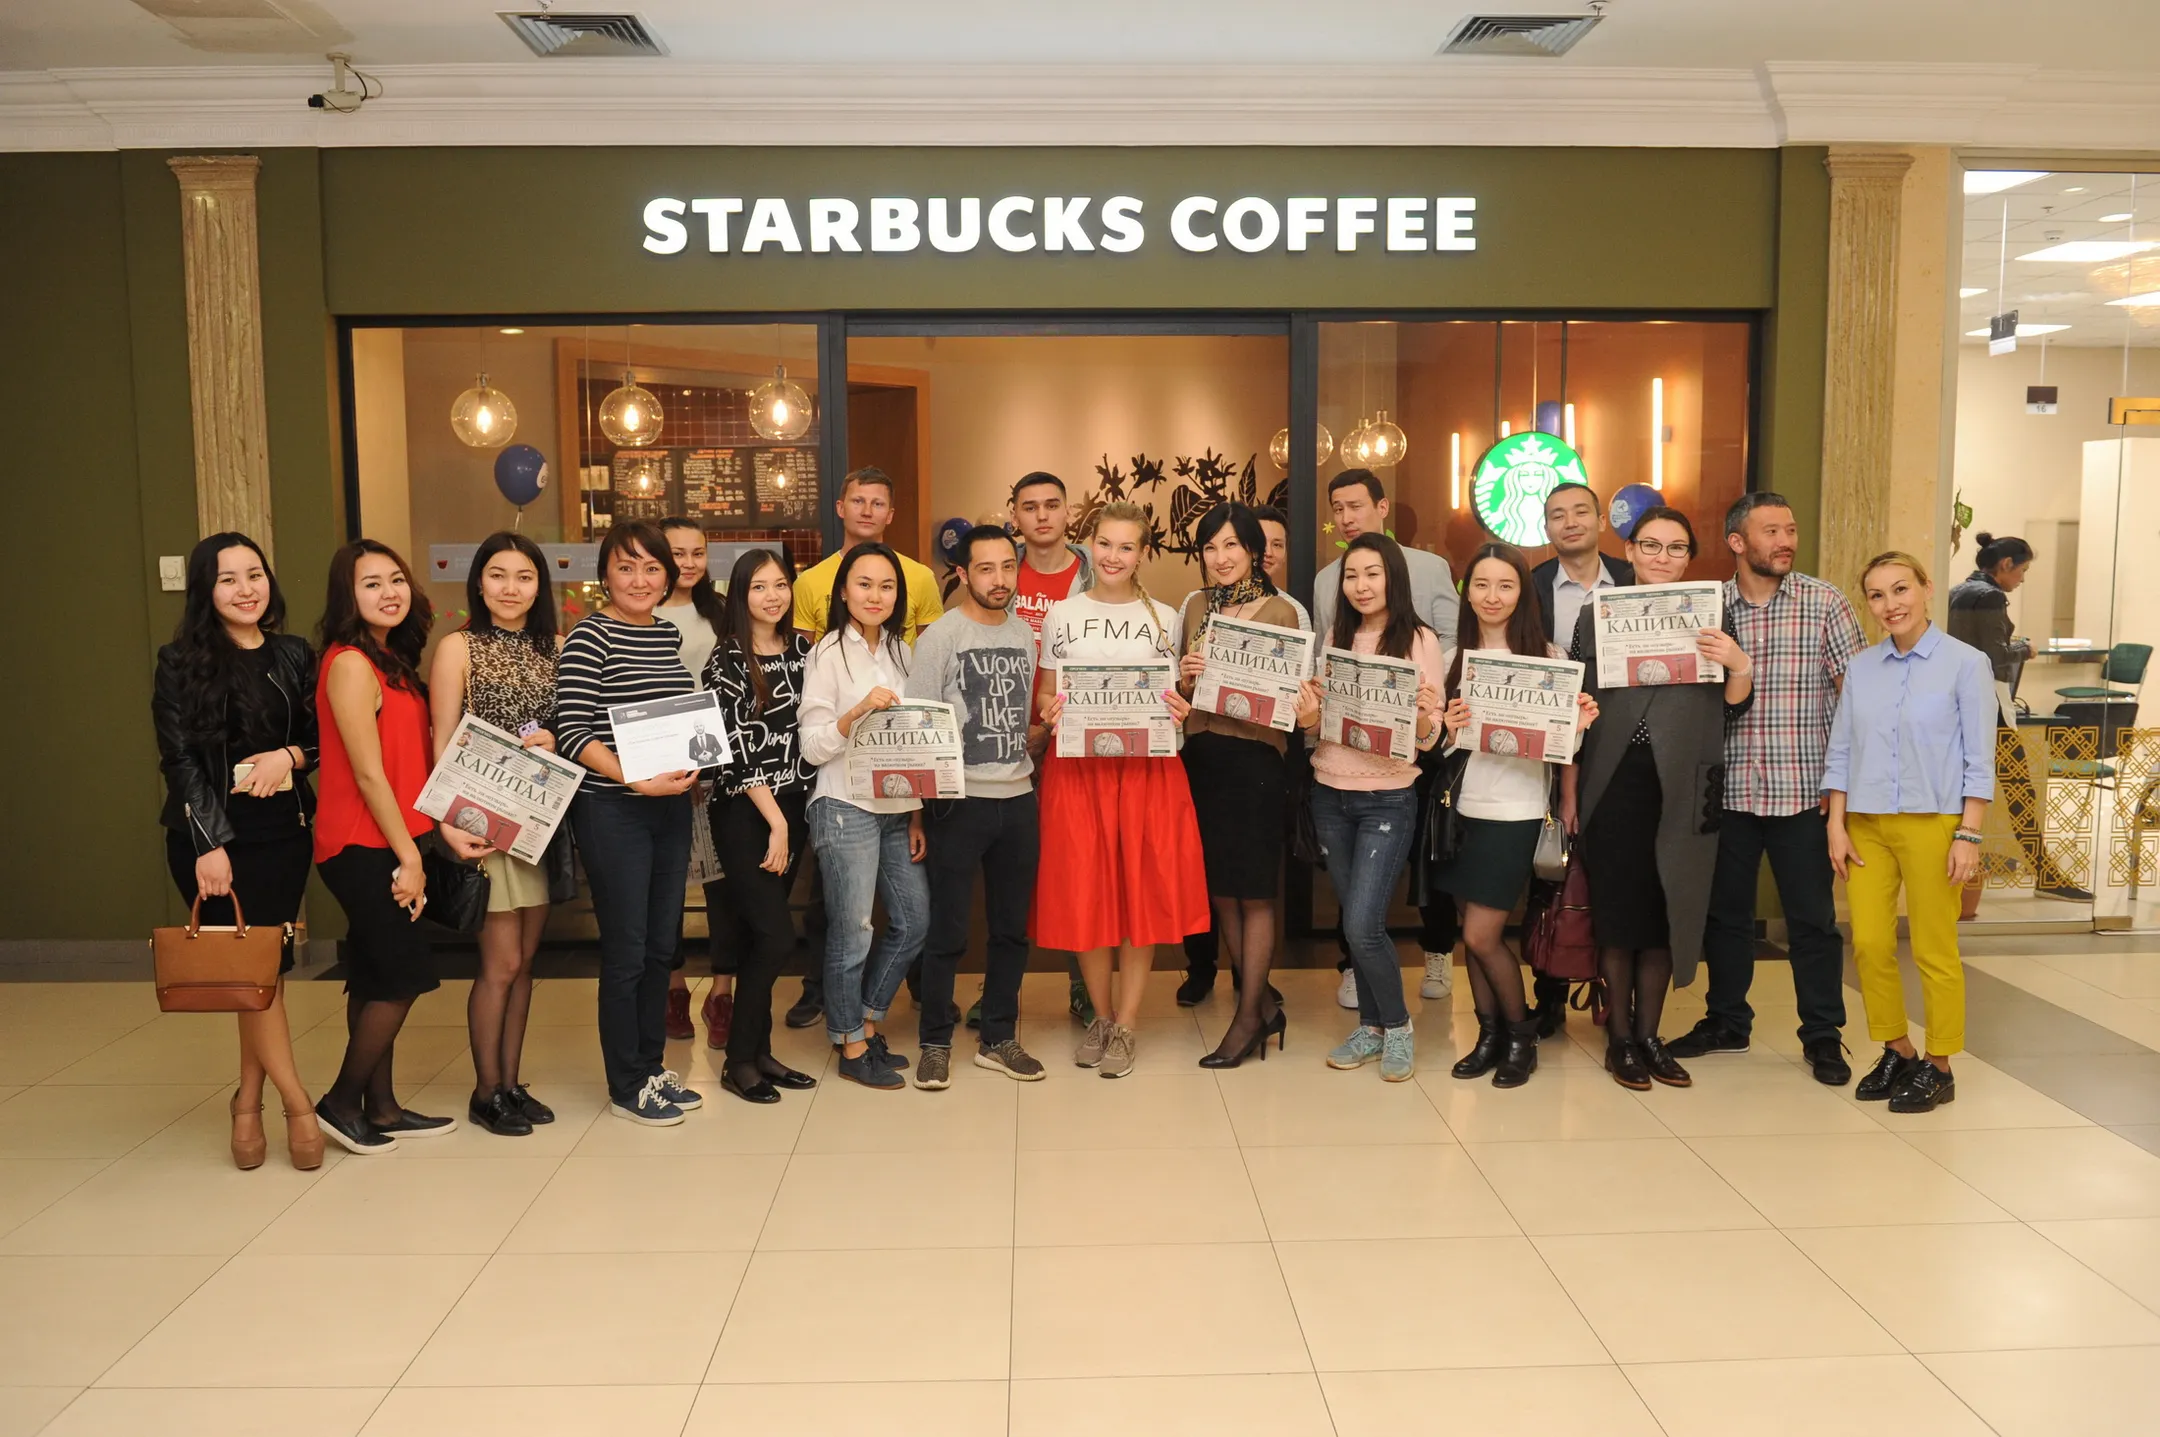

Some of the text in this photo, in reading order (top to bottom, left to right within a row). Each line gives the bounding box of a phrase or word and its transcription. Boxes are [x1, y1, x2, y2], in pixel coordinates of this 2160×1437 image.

[643, 196, 1477, 254] STARBUCKS COFFEE
[1607, 615, 1702, 633] КАПИТАЛ
[969, 653, 1030, 692] WOKE
[1209, 647, 1289, 675] КАПИТАЛ
[989, 673, 1015, 707] UP
[1067, 691, 1158, 705] КАПИТАЛ
[1328, 680, 1402, 706] КАПИТАЛ
[1469, 684, 1560, 707] КАПИТАЛ
[981, 697, 1025, 733] LIKE
[853, 731, 943, 748] КАПИТАЛ
[977, 731, 1026, 760] THIS
[454, 750, 547, 806] КАПИТАЛ
